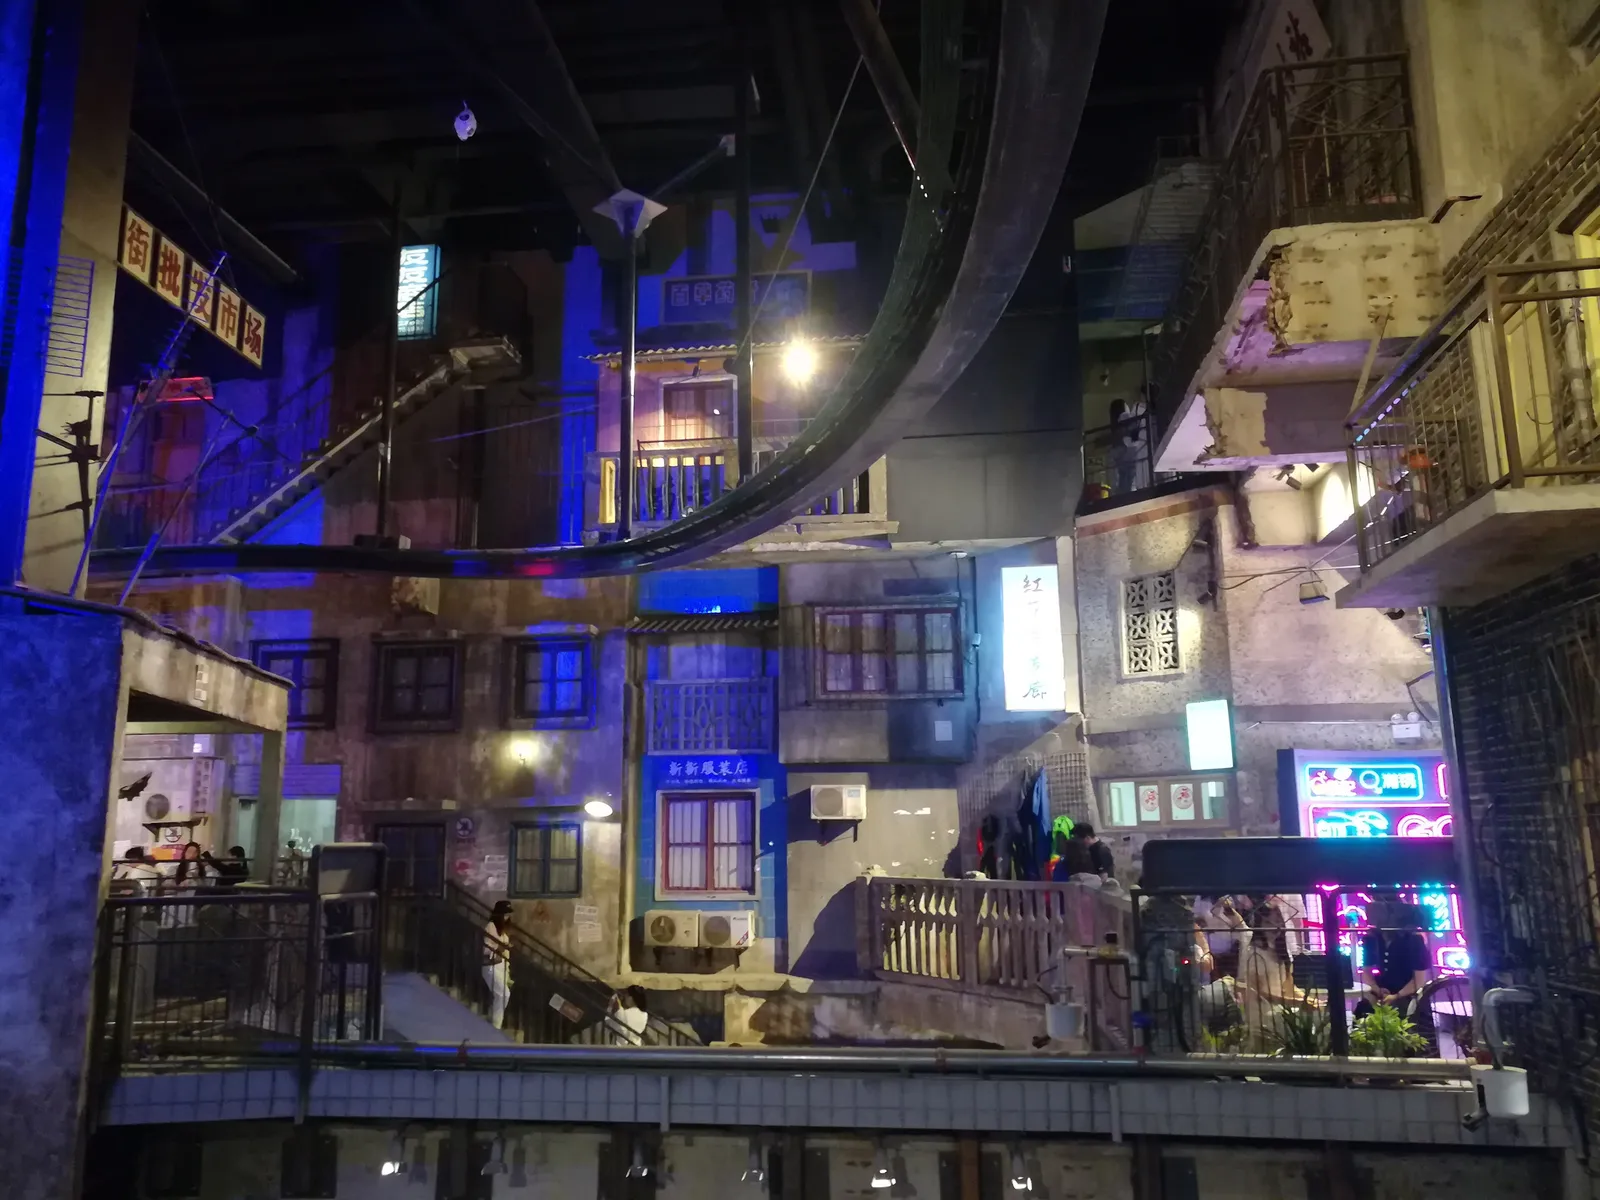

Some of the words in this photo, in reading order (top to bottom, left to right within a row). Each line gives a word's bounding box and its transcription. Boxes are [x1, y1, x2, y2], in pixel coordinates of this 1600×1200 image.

[669, 759, 749, 776] 新新服装店
